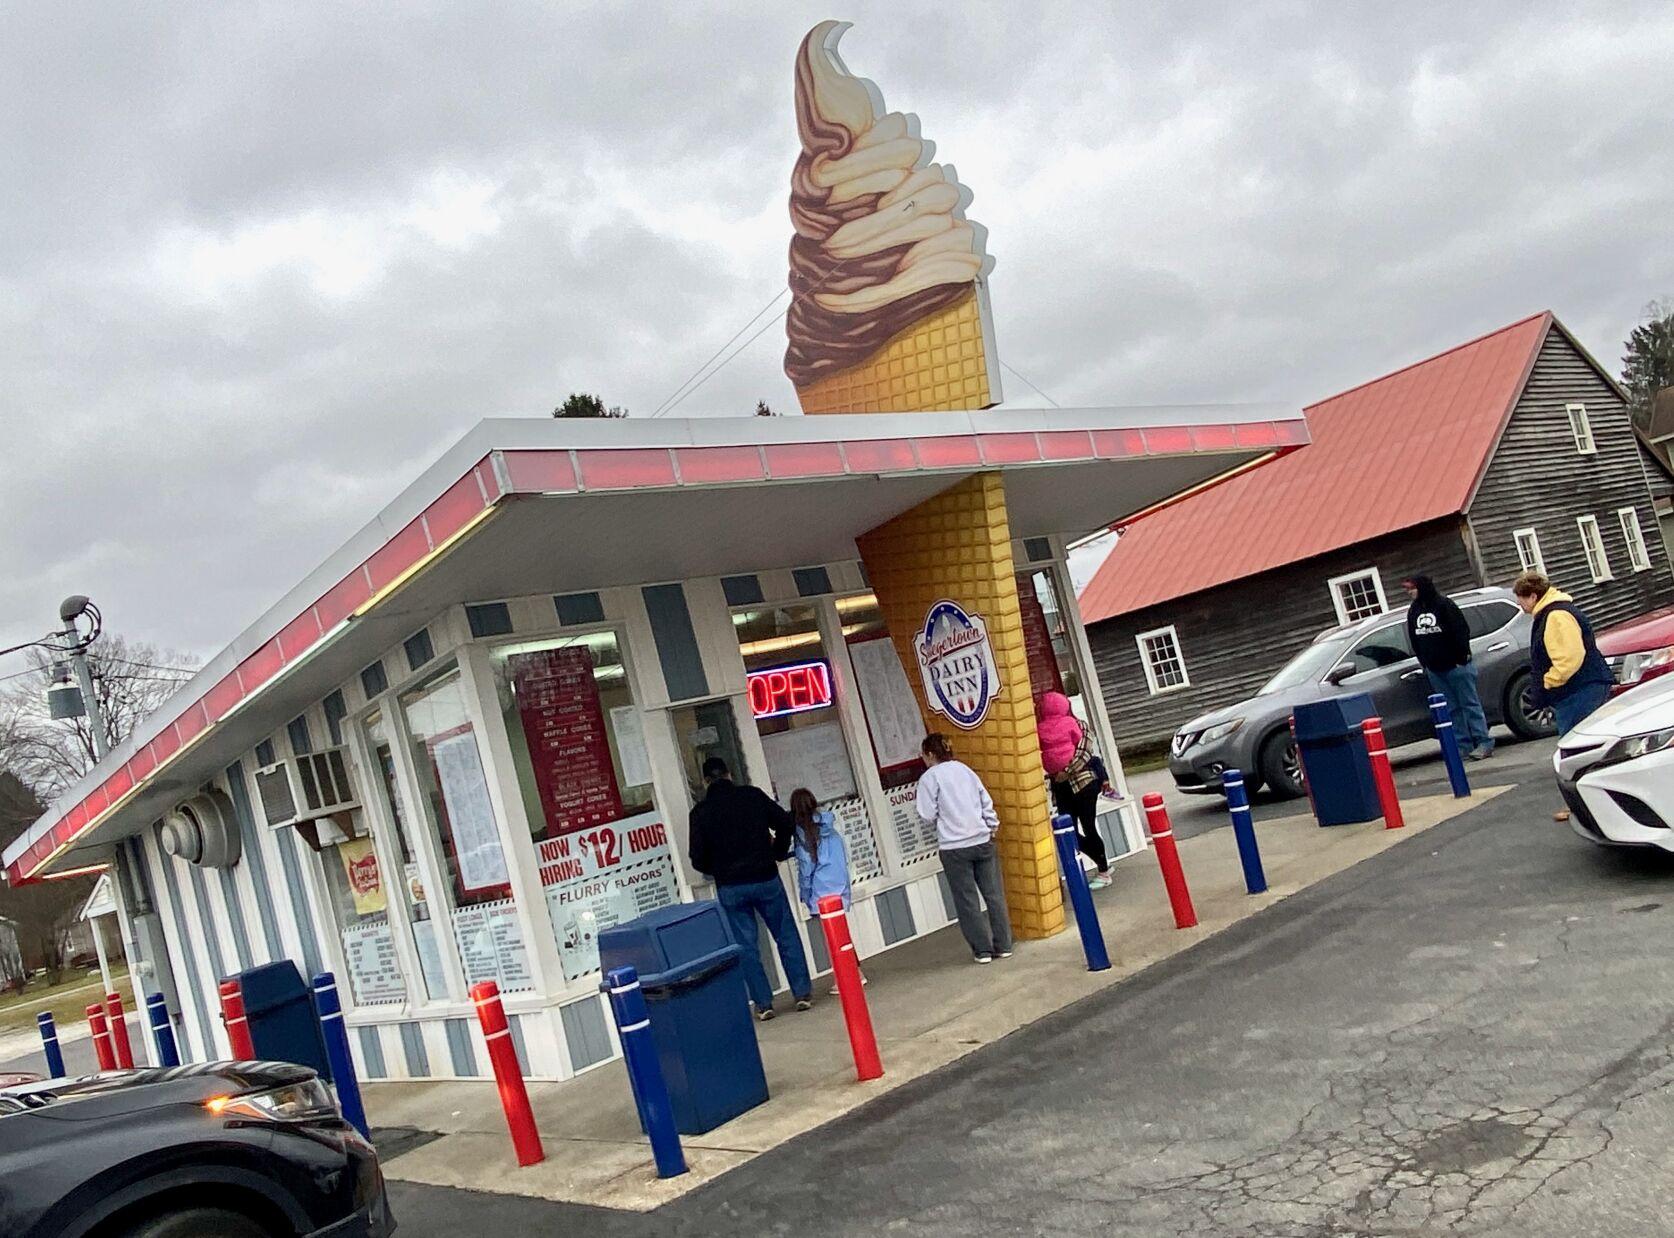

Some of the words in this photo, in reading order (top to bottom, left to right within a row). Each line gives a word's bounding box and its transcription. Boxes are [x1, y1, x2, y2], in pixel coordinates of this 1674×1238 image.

[930, 653, 983, 681] DAIRY
[750, 666, 829, 715] OPEN
[946, 675, 978, 697] INN
[541, 838, 569, 862] NOW
[627, 823, 668, 854] HOUR
[539, 859, 583, 887] HIRING
[560, 880, 610, 905] FLURRY
[614, 868, 662, 889] FLAVORS
